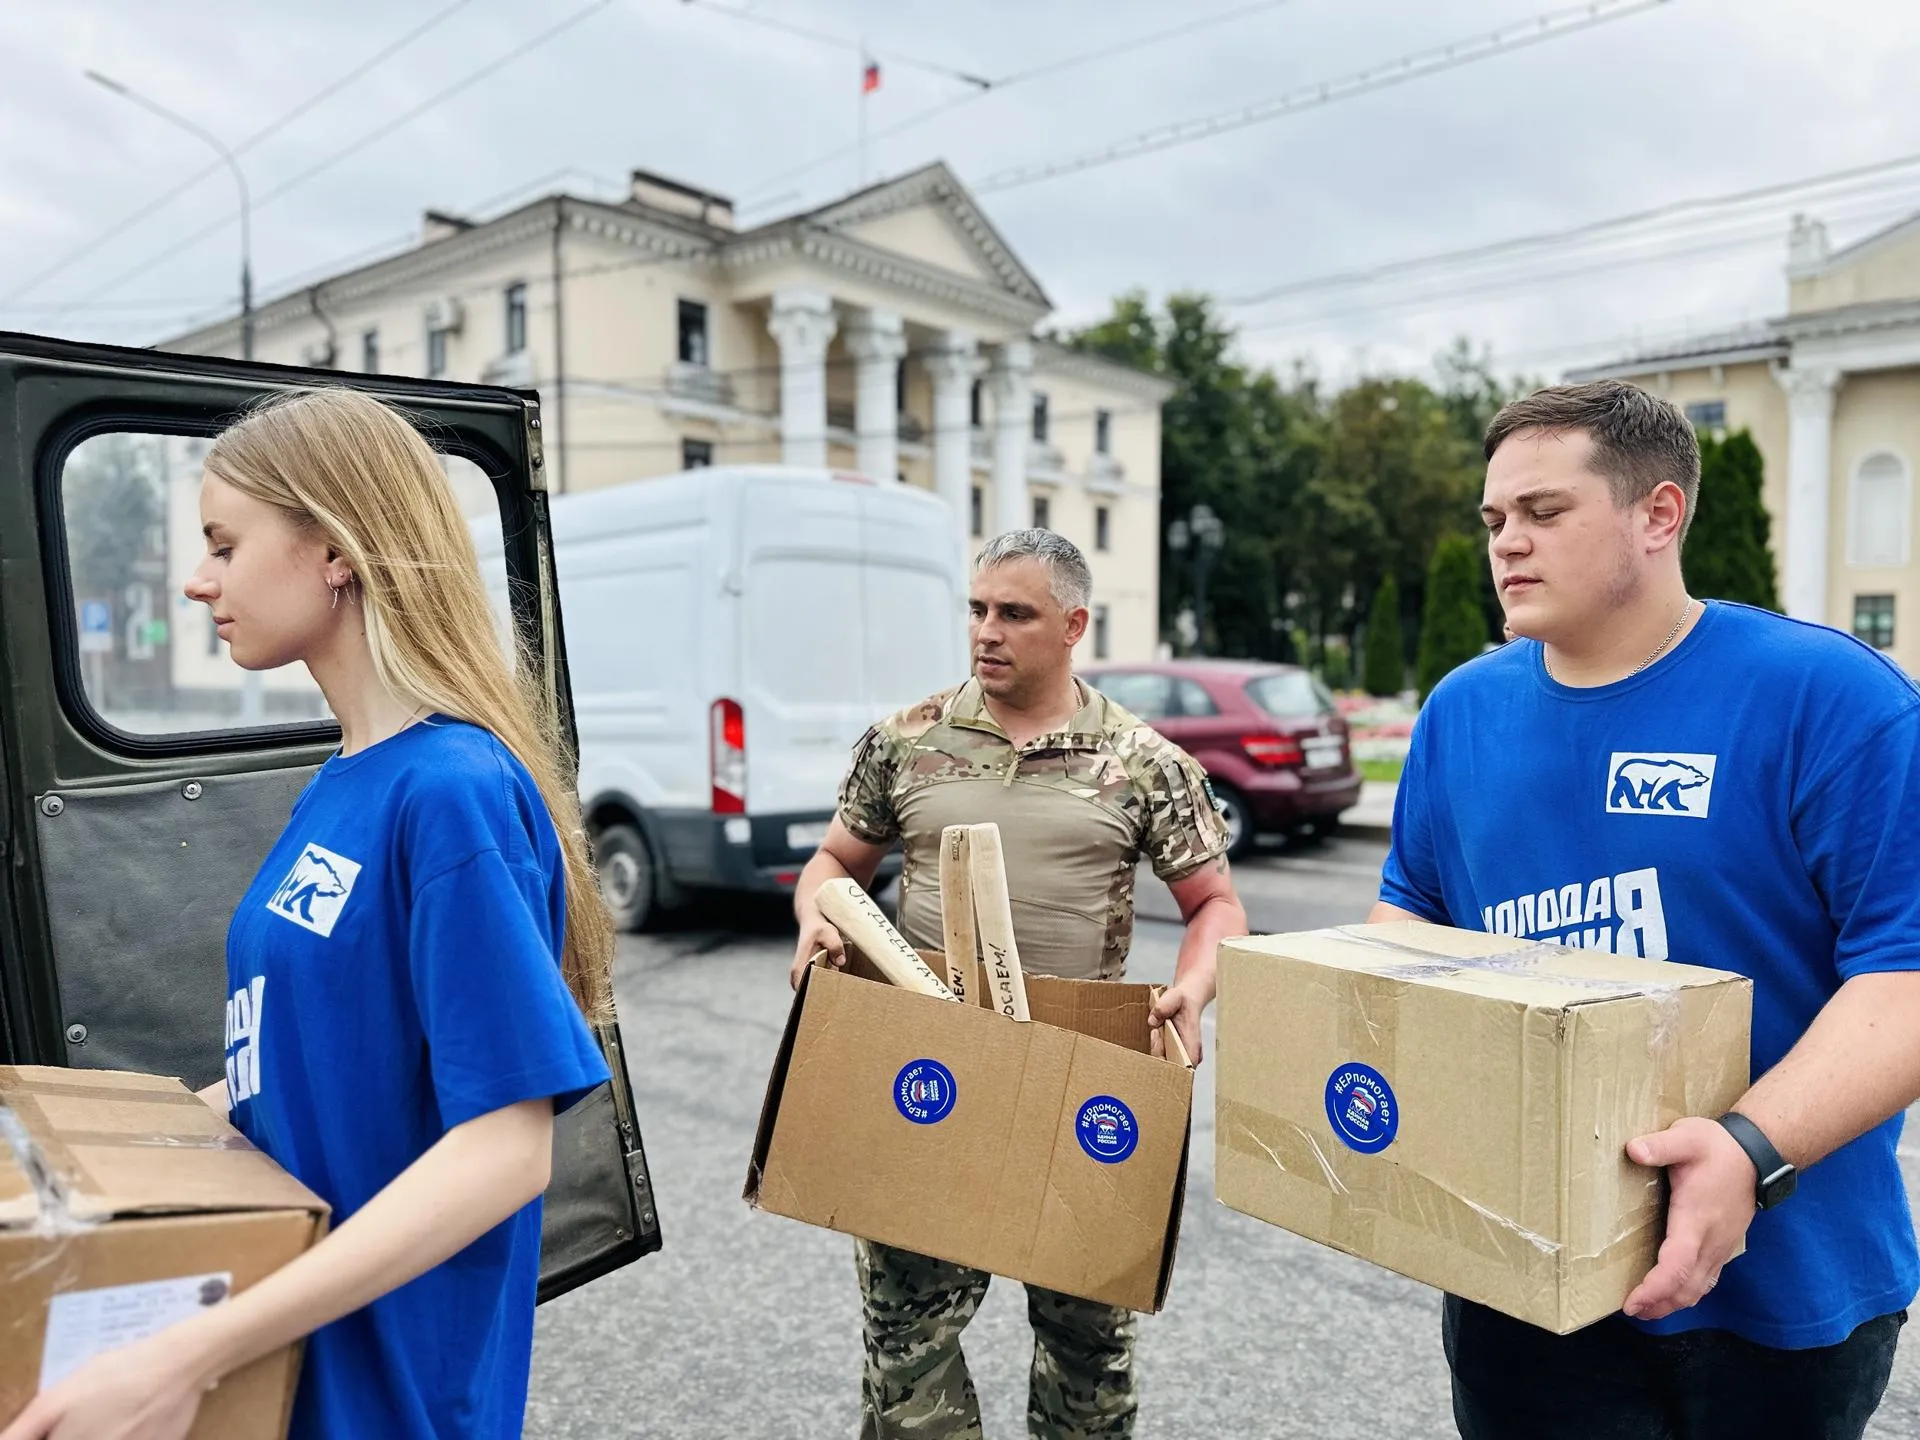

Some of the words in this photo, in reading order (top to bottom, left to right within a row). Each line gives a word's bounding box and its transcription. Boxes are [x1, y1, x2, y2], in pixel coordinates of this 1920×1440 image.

[950, 966, 965, 1002] ЕМ!
[901, 1066, 928, 1119] #ЕРпомогает
[1334, 1072, 1390, 1126] #ЕРпомогает
[1081, 1103, 1131, 1133] #ЕРпомогает
